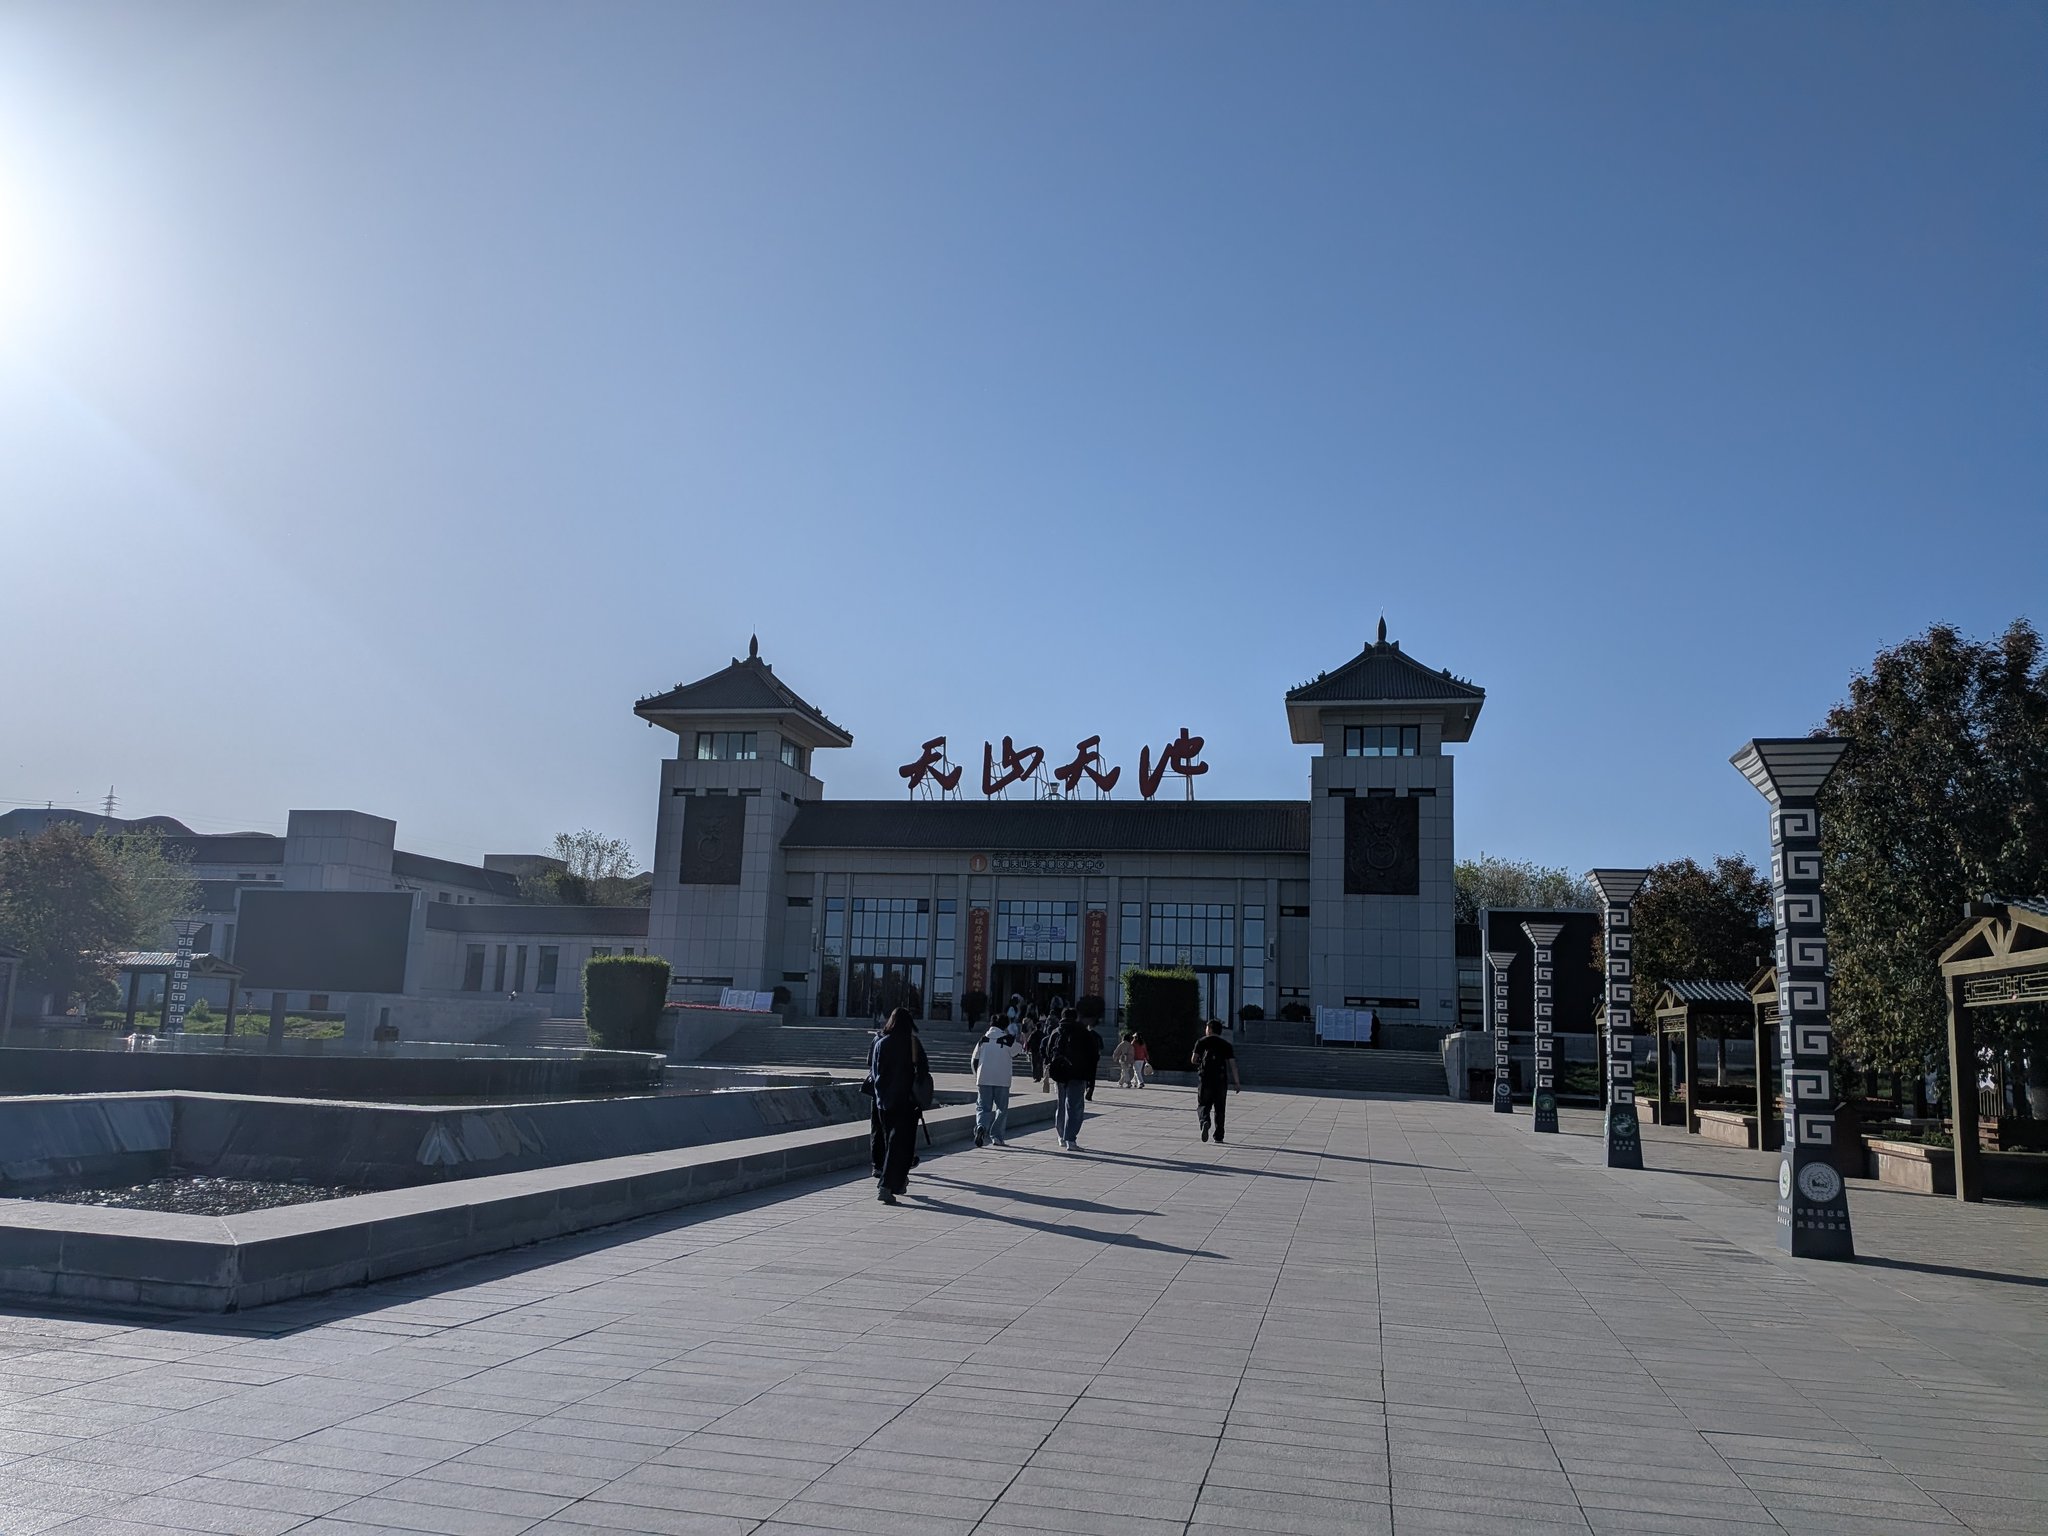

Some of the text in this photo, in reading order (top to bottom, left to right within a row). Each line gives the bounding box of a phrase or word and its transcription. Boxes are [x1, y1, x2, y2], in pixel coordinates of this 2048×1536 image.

[898, 728, 1209, 798] 天山天池
[992, 859, 1105, 870] 新疆天山天池景区游客中心
